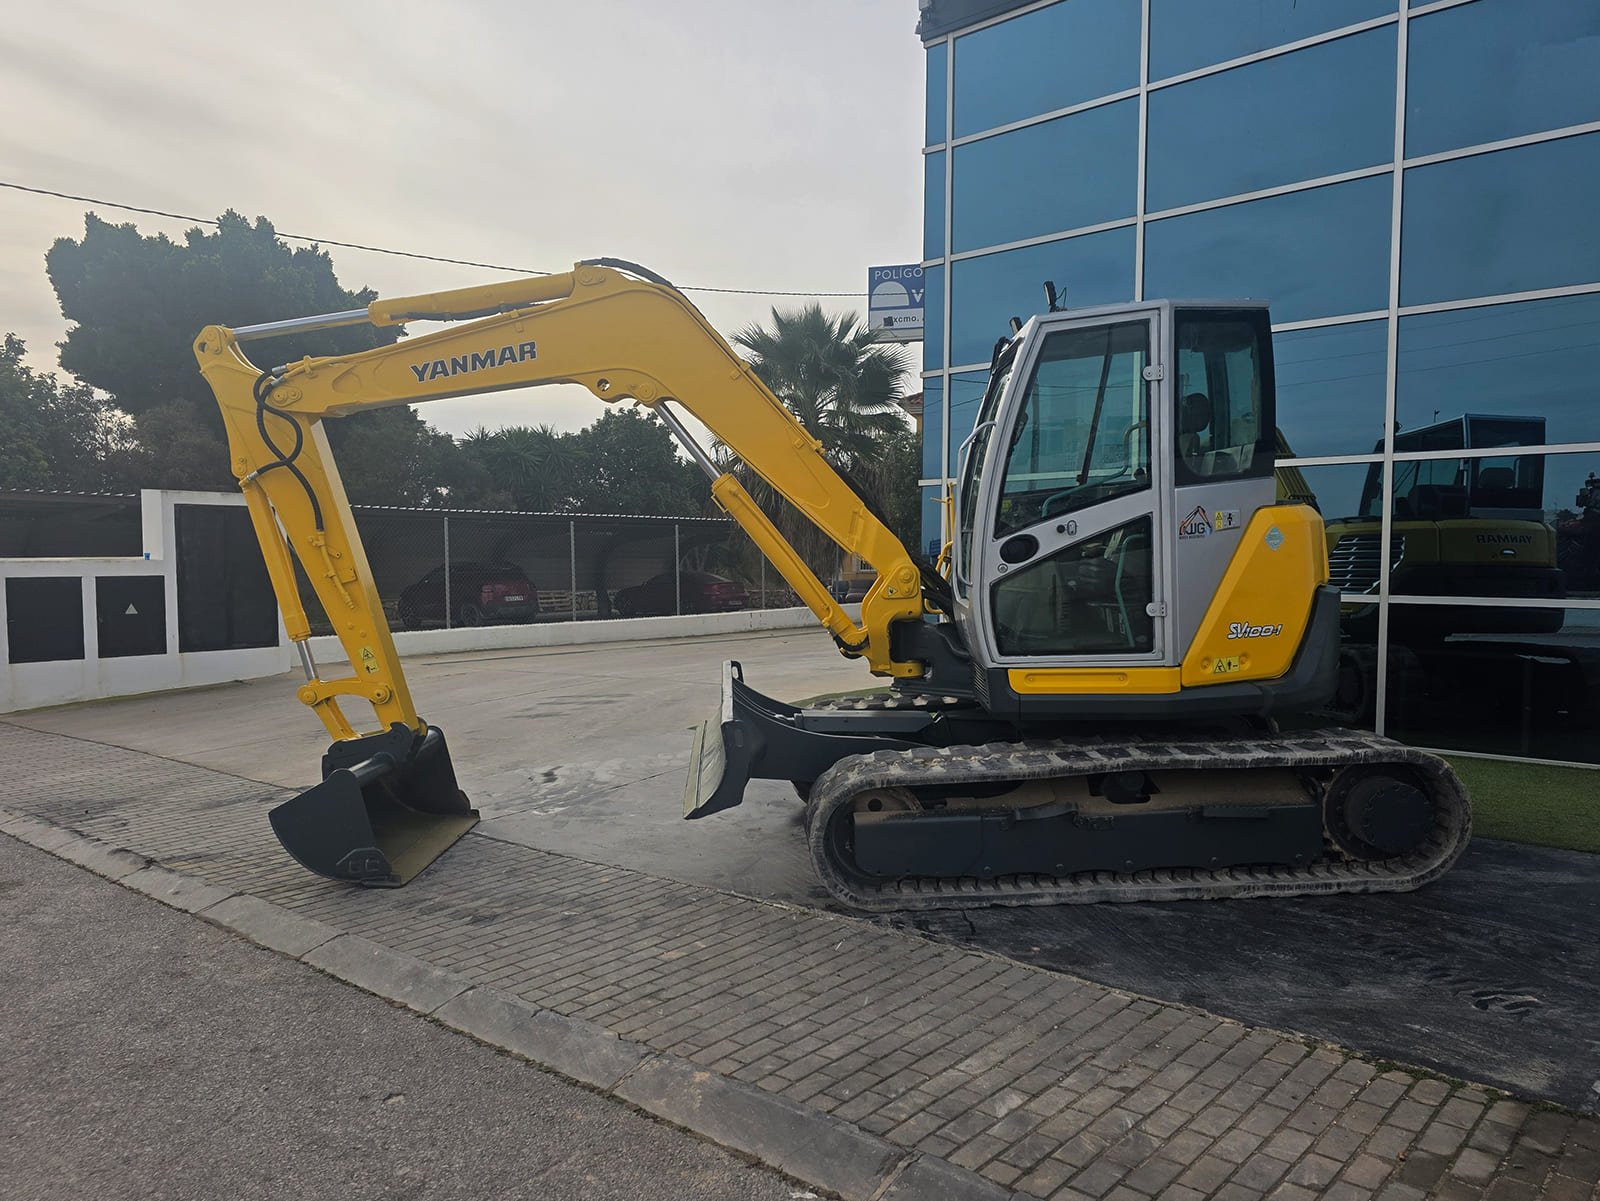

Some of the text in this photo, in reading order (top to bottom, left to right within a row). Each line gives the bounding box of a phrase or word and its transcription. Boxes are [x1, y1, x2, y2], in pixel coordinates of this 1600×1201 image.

[887, 315, 919, 325] xcmo.
[409, 340, 537, 382] YANMAR
[1227, 621, 1283, 639] SV100-1
